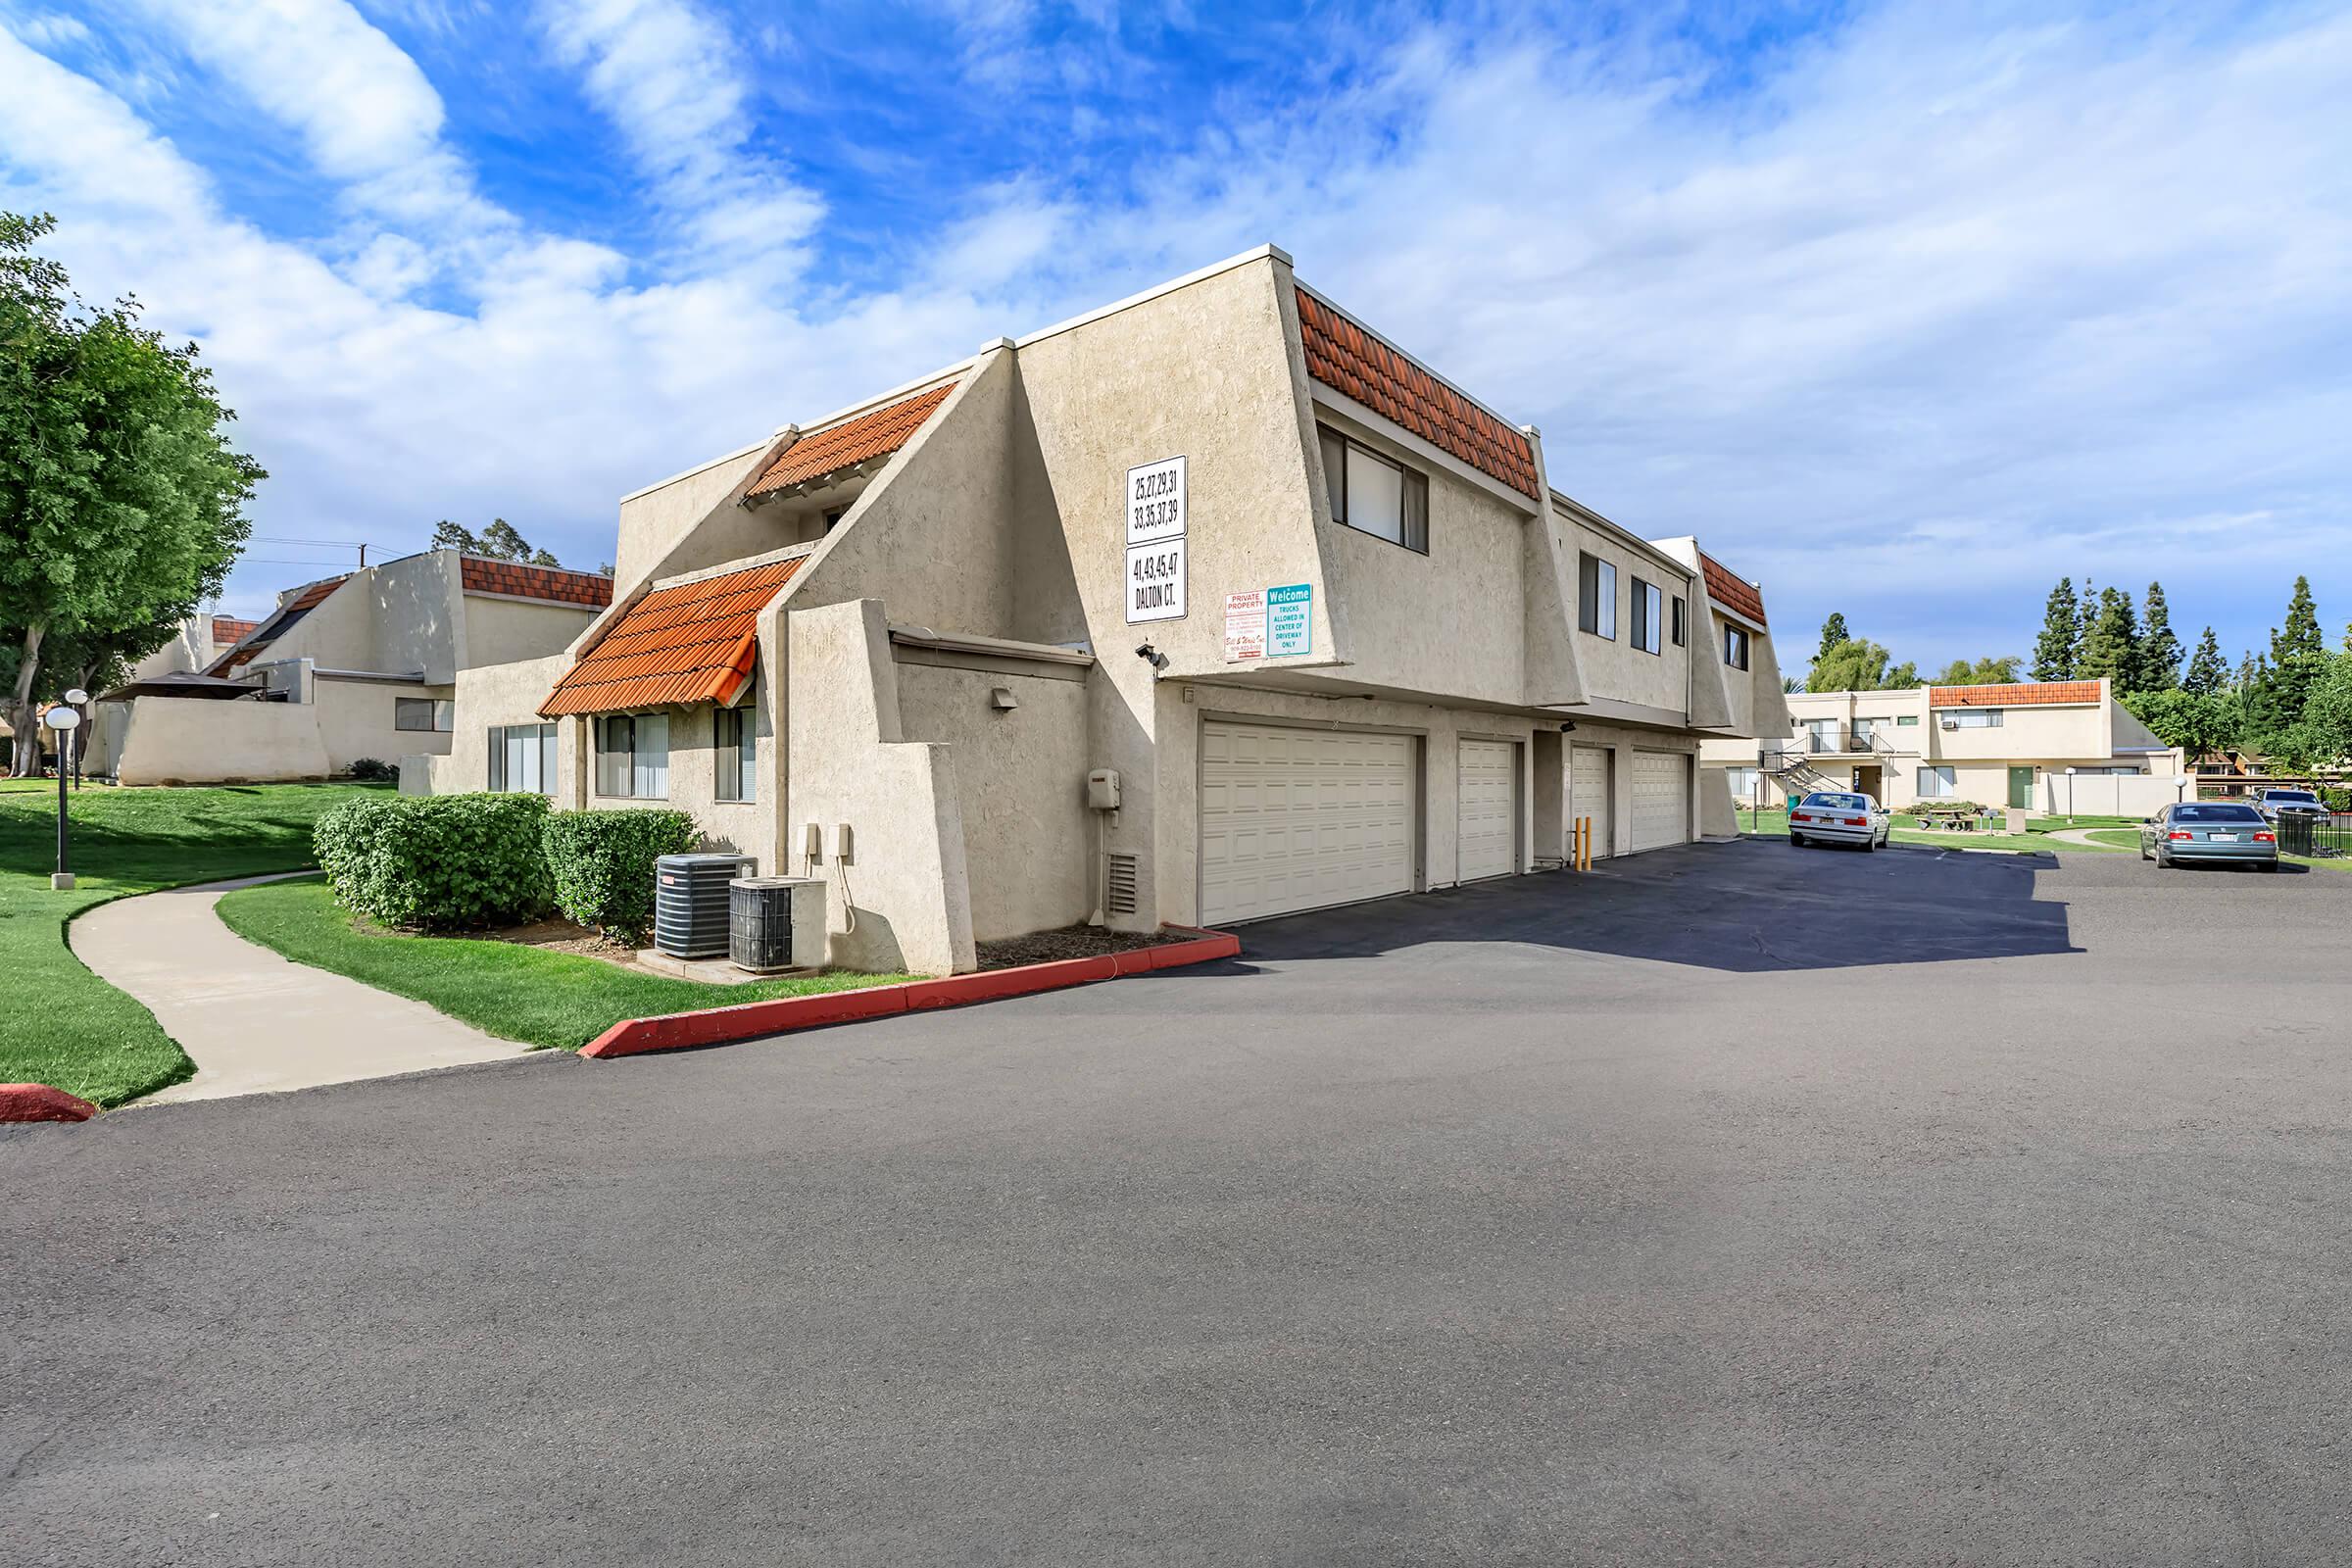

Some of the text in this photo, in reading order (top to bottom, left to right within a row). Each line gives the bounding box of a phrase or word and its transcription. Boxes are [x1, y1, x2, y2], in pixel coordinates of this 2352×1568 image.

[1136, 469, 1177, 501] 25,27,29,31
[1134, 499, 1178, 530] 33,35,37,39
[1134, 552, 1178, 582] 41,43,45,47
[1136, 583, 1176, 610] DALTON CT.
[1228, 601, 1263, 610] PROPERTY
[1232, 593, 1260, 603] PRIVATE
[1269, 590, 1309, 603] Welcome
